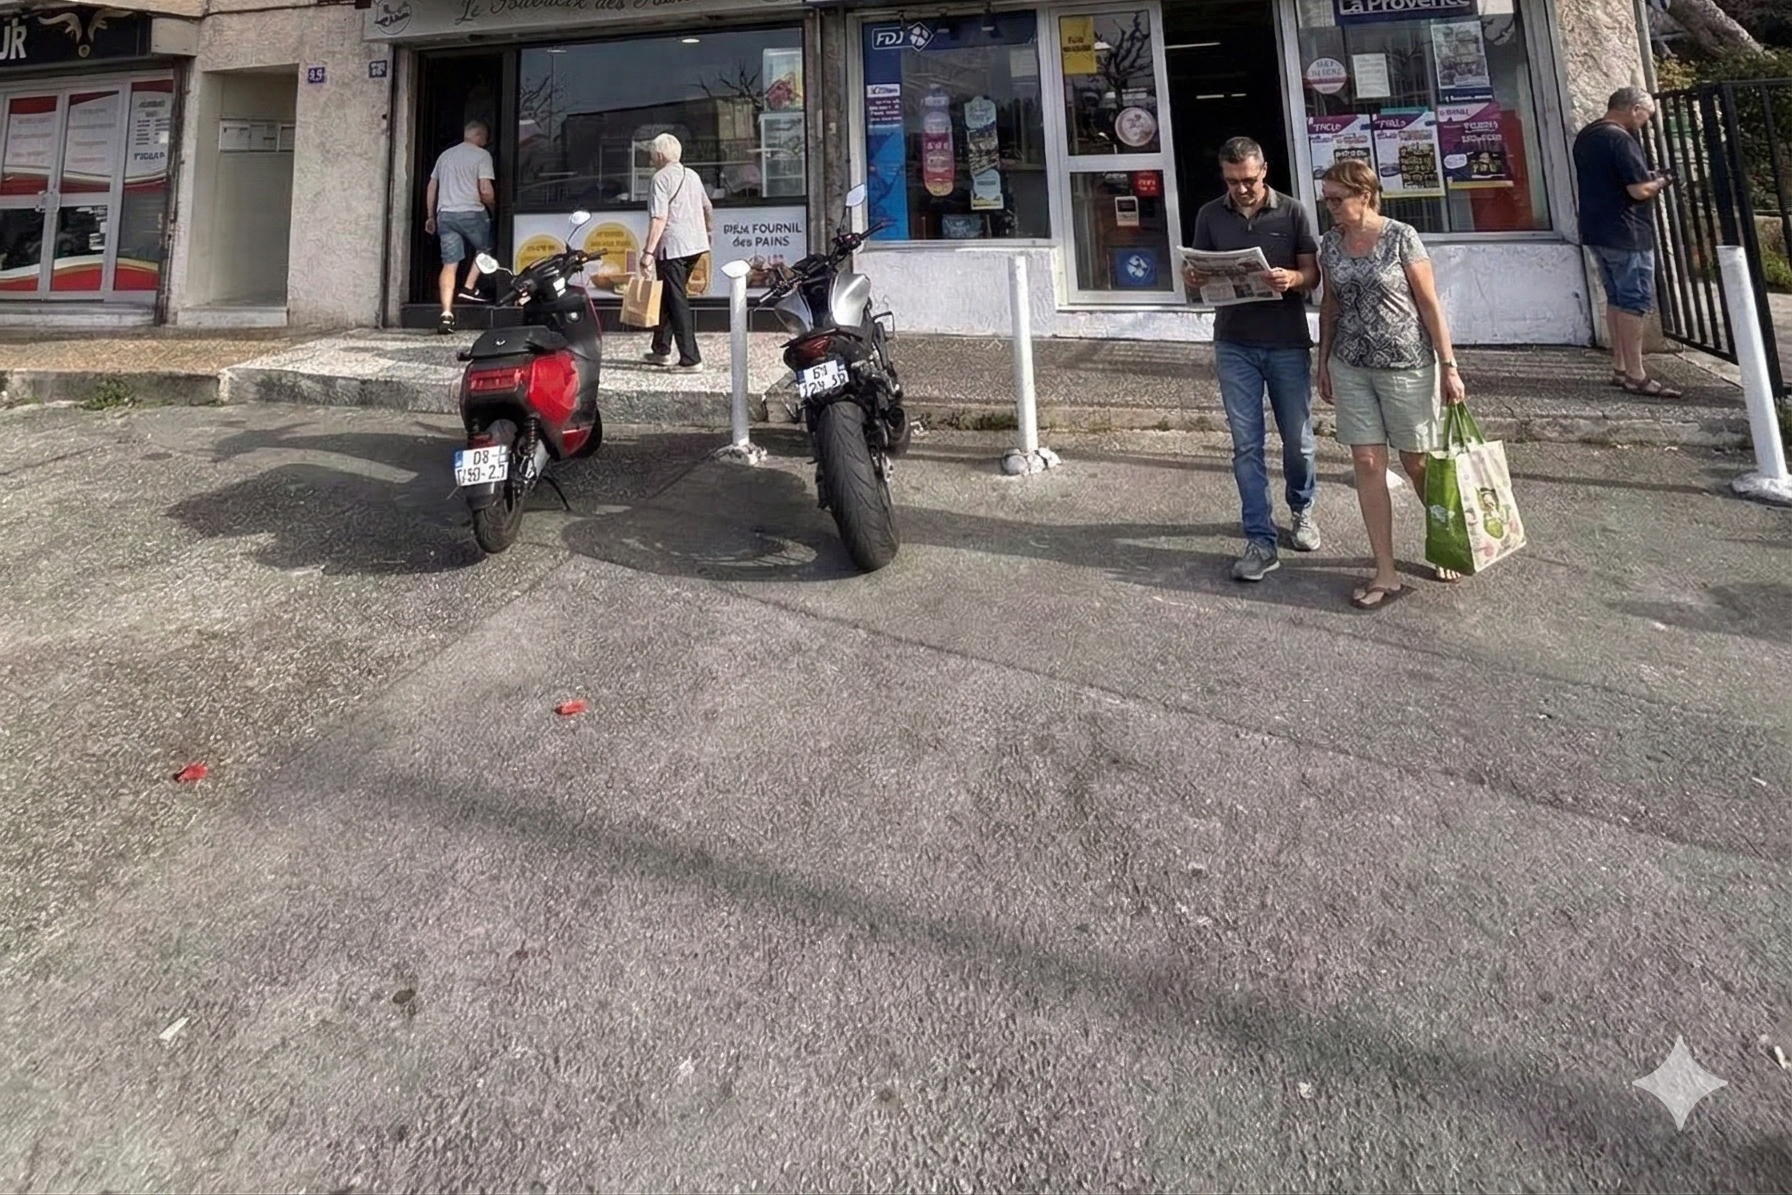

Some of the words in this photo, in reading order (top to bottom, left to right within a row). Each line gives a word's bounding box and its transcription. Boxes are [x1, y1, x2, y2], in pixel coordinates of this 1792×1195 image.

[876, 31, 905, 46] FDJ
[752, 222, 802, 234] FOURNIL
[755, 236, 789, 247] PAINS
